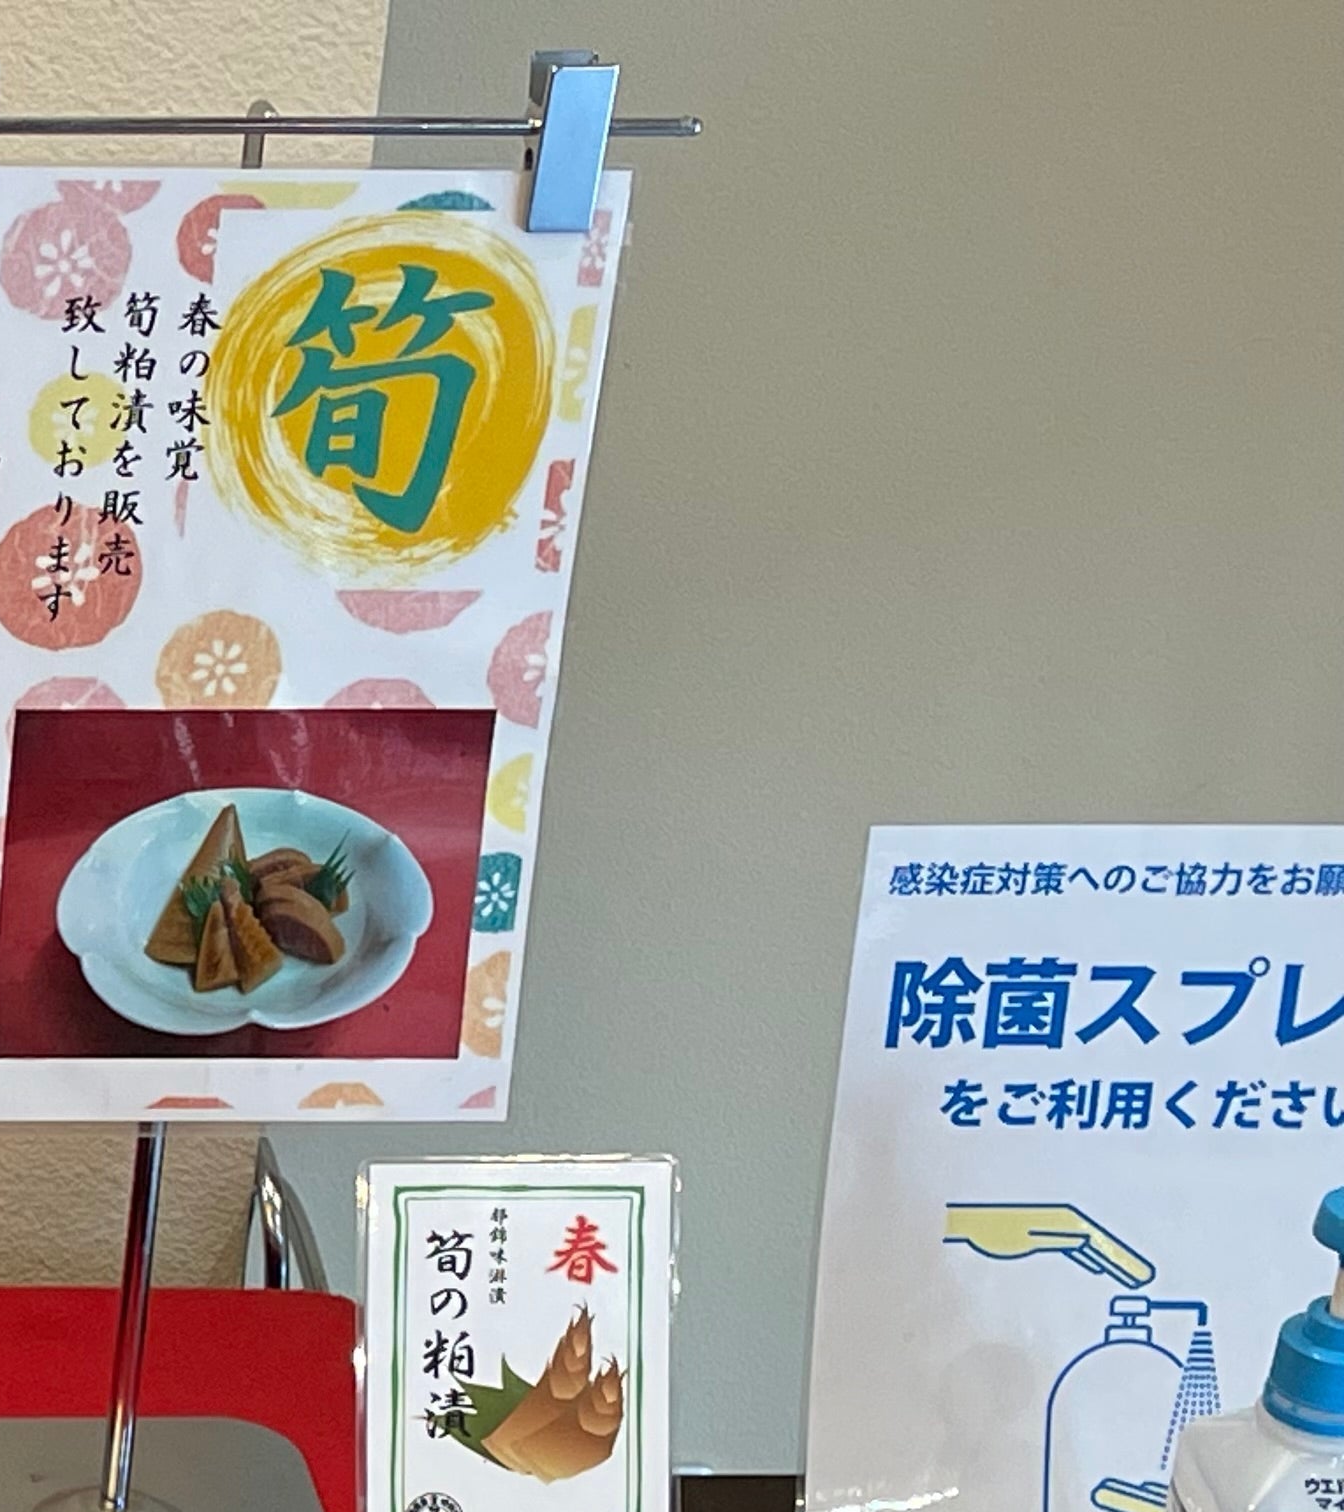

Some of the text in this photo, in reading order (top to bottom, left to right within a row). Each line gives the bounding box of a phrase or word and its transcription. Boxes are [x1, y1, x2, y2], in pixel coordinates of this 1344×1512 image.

[39, 294, 105, 623] 致しております
[96, 291, 162, 577] 筍粕漬を販売
[163, 292, 222, 483] 春の味覚
[271, 262, 495, 535] 筍
[888, 861, 1344, 896] 感染症対策へのご協力をお願
[885, 955, 1344, 1050] 除菌スプレ
[422, 1229, 477, 1439] 筍の粕漬
[545, 1215, 618, 1285] 春
